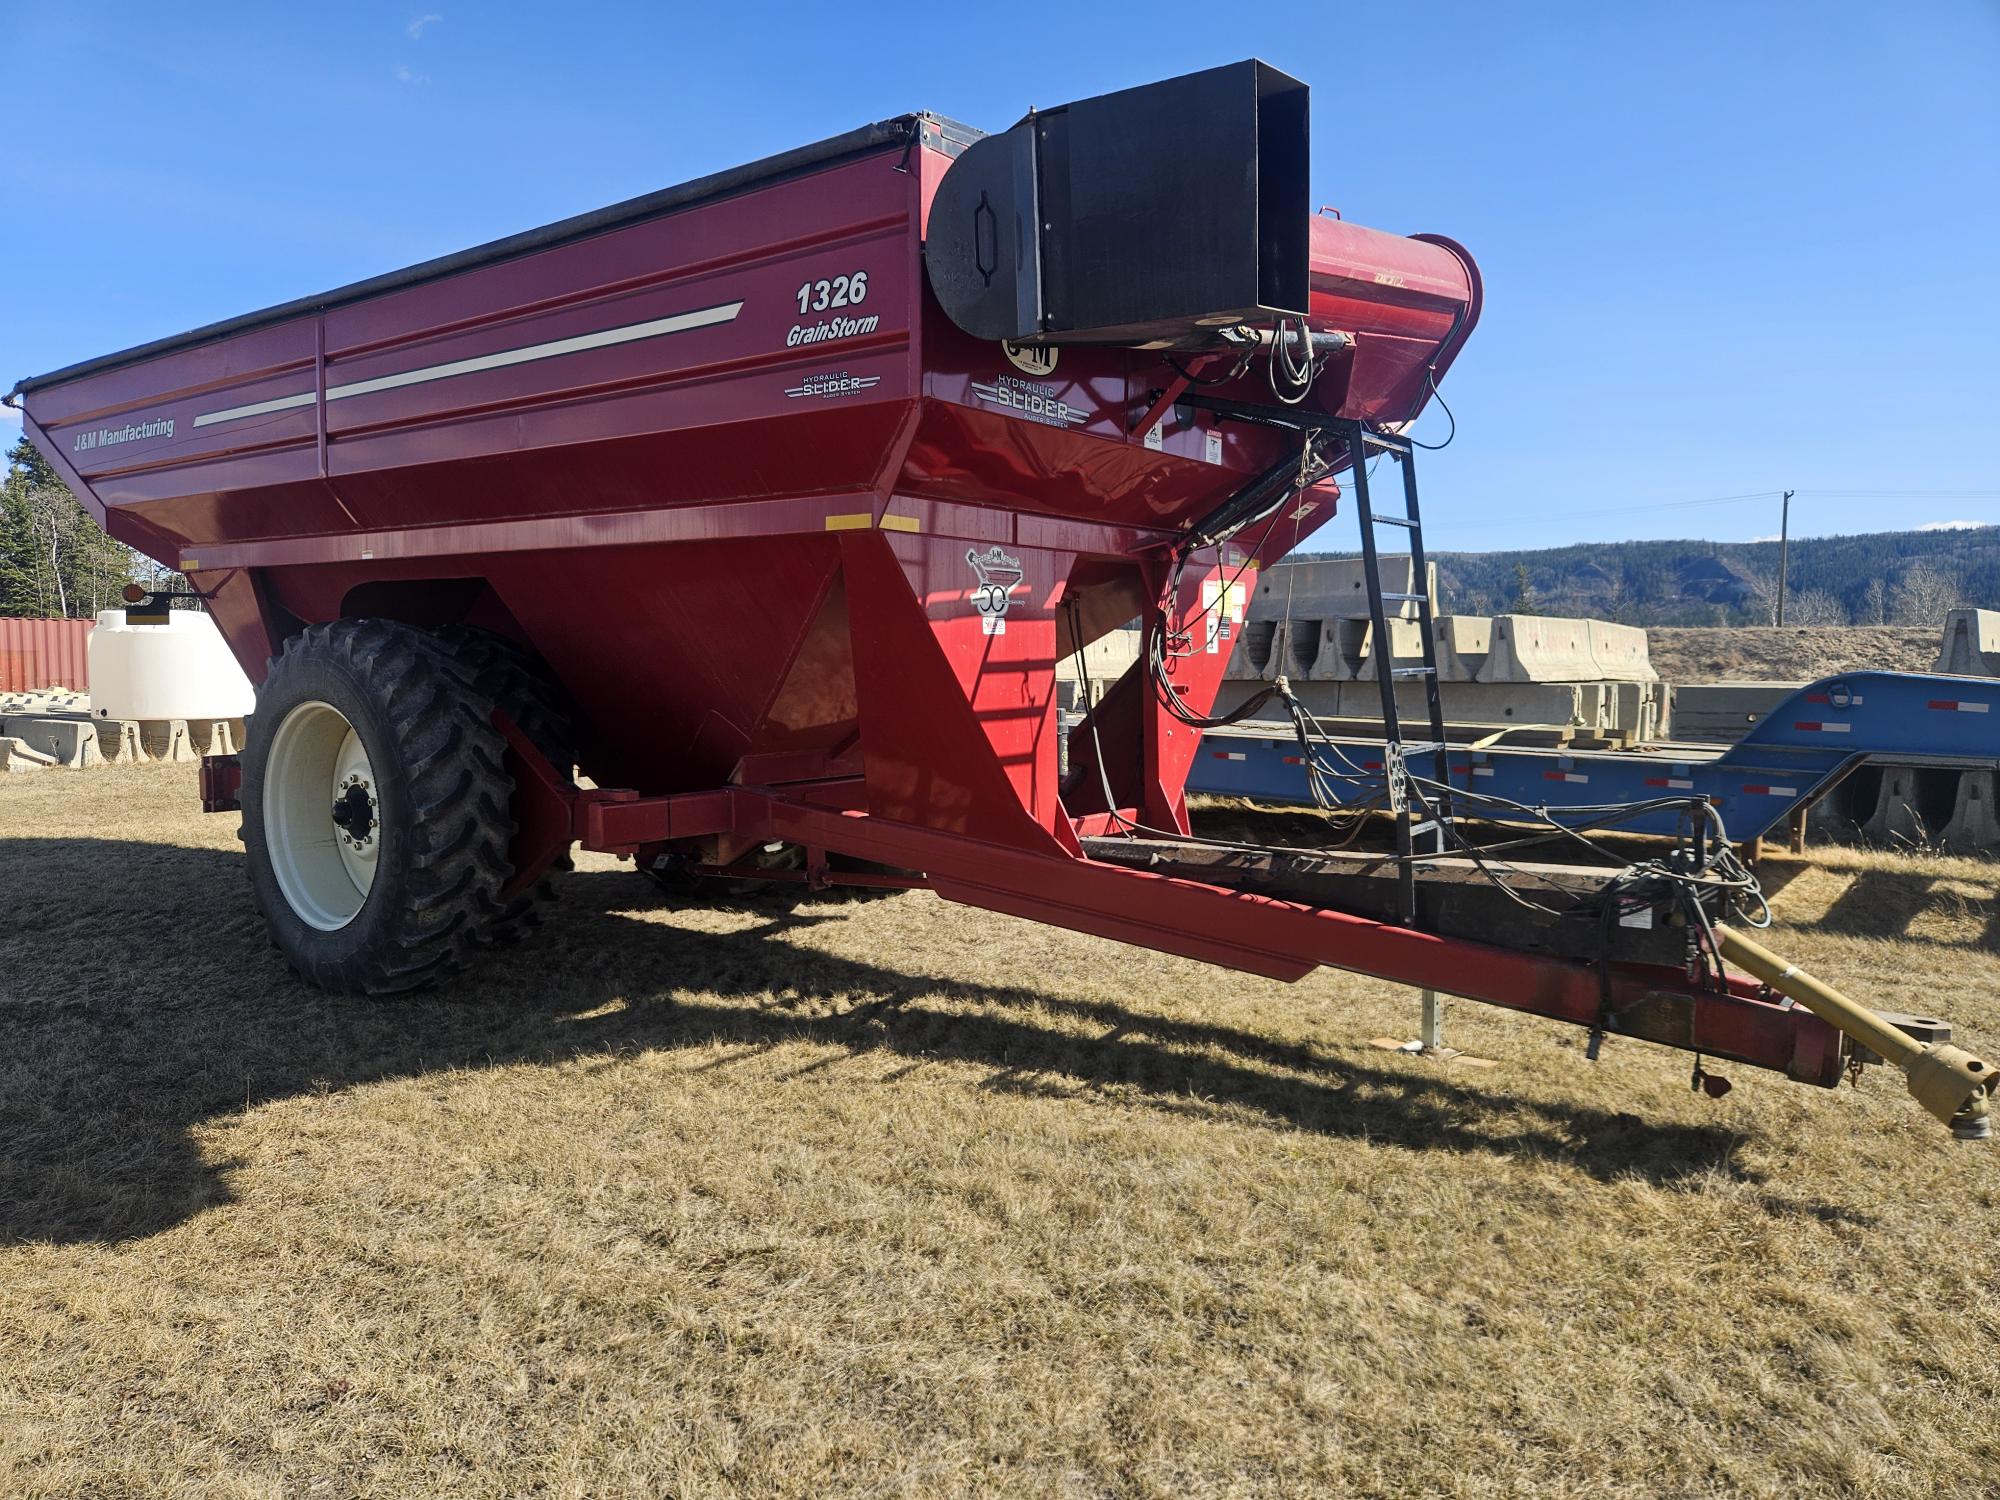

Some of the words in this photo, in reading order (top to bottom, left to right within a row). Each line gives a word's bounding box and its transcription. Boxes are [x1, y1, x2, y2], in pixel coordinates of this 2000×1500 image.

[796, 270, 868, 314] 1326
[786, 315, 879, 347] GrainStorm
[803, 371, 848, 384] HYDRAULIC
[803, 377, 860, 396] SLIDER
[998, 374, 1054, 398] HYDRAULIC
[998, 386, 1069, 421] SLIDER
[74, 430, 96, 452] J&M
[98, 418, 175, 446] Manufacturing
[980, 583, 1006, 612] 50
